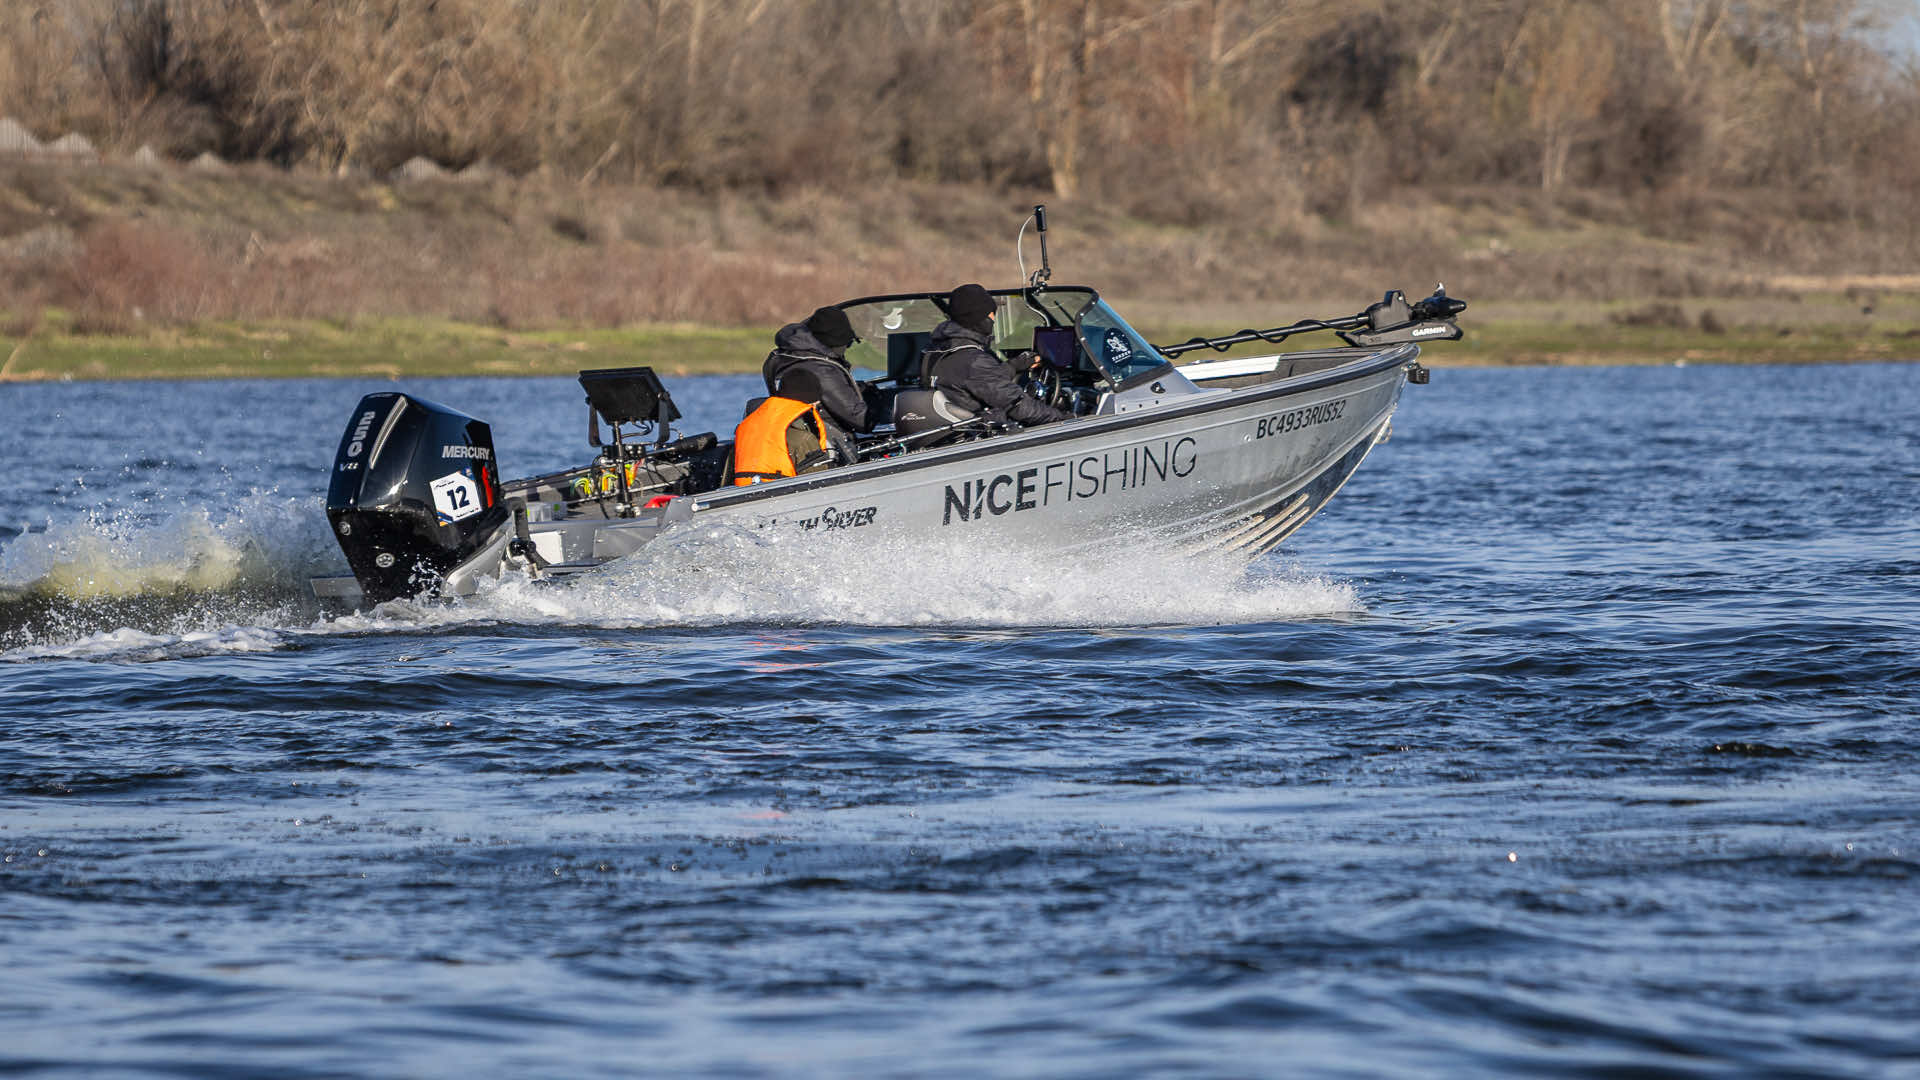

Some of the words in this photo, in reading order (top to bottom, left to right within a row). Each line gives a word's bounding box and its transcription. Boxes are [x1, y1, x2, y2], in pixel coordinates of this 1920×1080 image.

[1412, 326, 1447, 336] GARMIN
[1256, 399, 1347, 439] BC4933RUS52
[441, 445, 490, 460] MERCURY
[446, 485, 470, 511] 12
